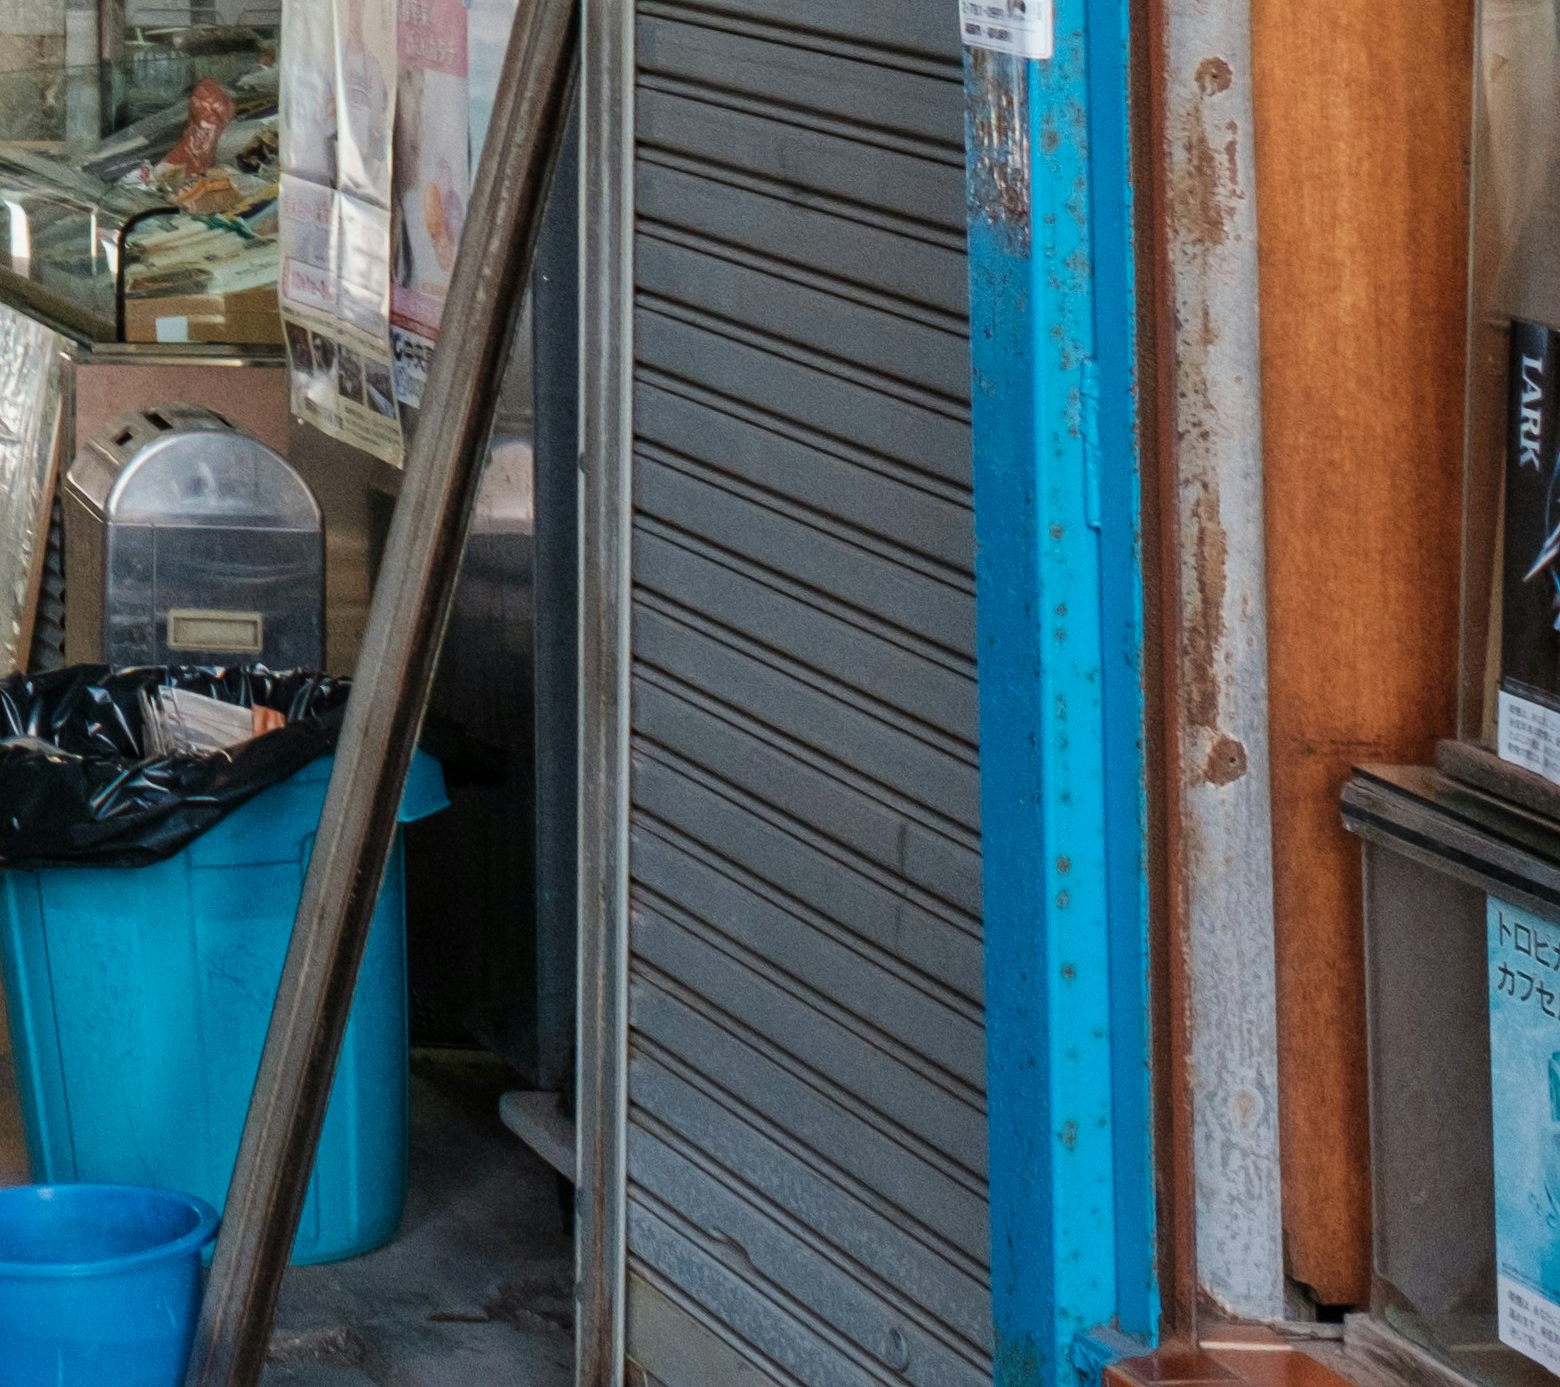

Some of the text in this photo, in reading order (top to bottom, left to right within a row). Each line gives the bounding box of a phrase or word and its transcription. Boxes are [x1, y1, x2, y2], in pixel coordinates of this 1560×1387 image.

[1519, 352, 1544, 473] LARK
[1497, 960, 1560, 1022] カプセ
